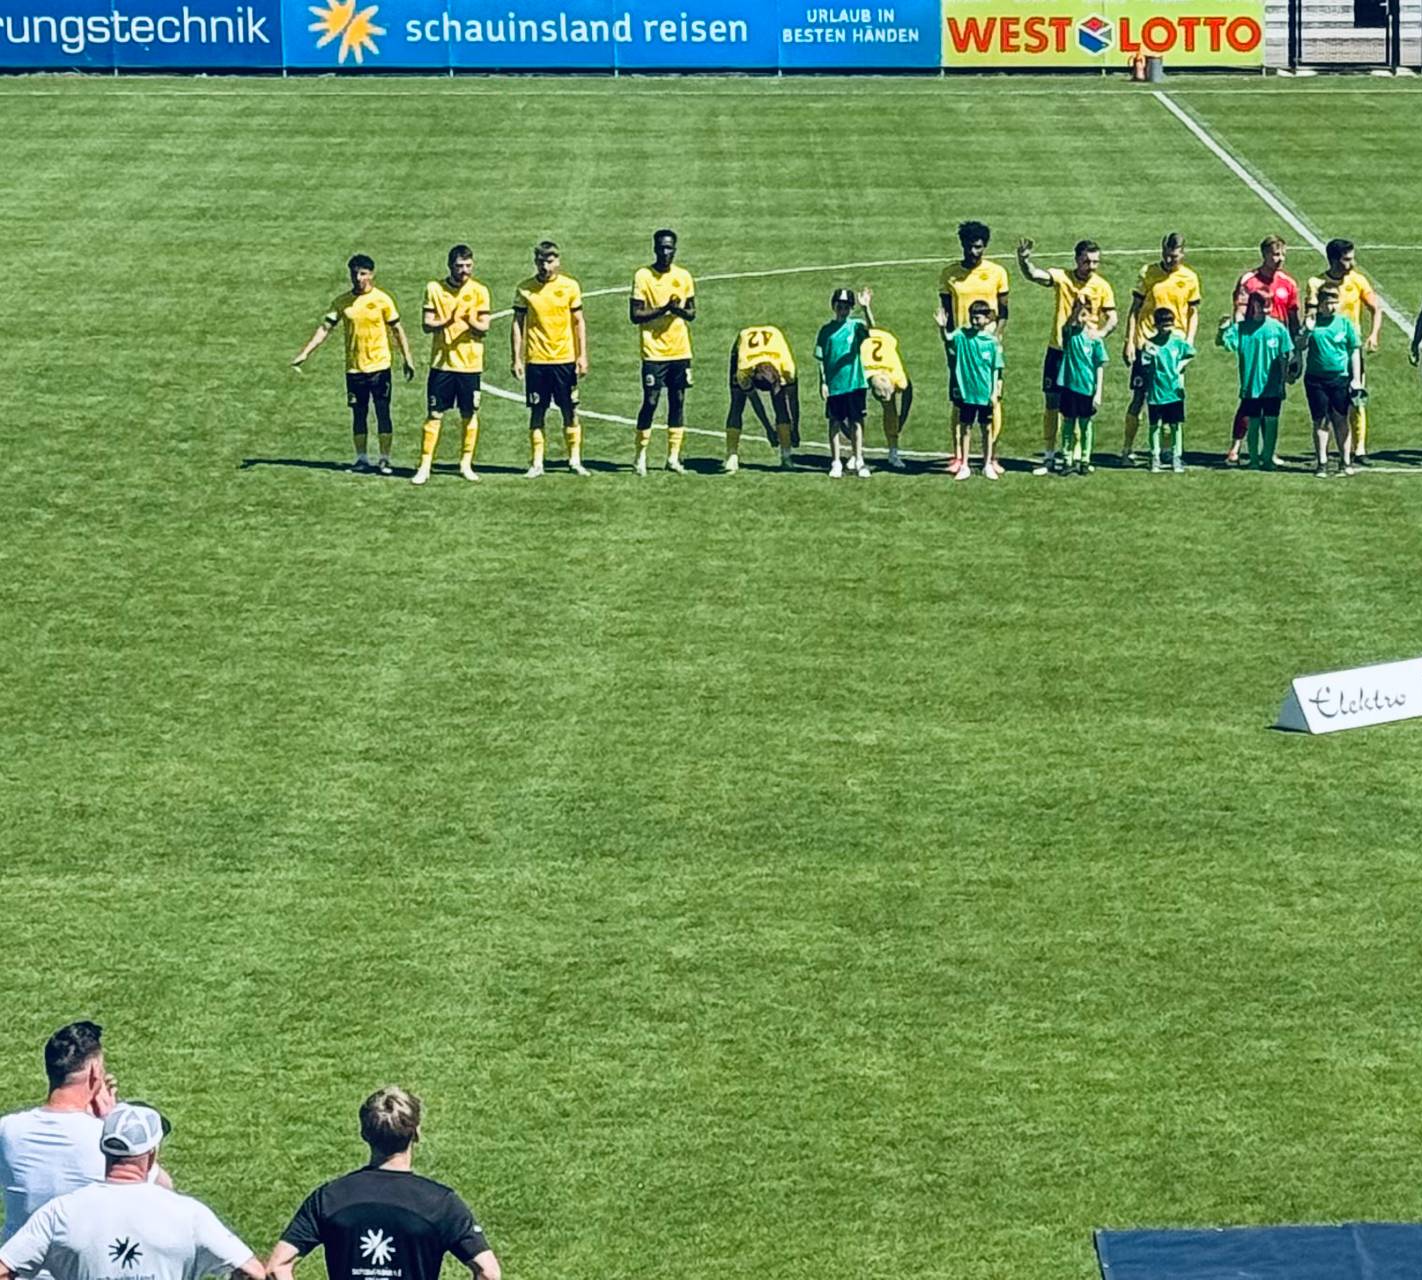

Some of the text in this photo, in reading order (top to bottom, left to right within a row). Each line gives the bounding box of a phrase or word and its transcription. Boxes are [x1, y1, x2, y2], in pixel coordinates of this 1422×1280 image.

[0, 6, 270, 54] ungstechnik
[405, 11, 748, 42] schauinsland reisen
[807, 8, 894, 23] URLAUB IN
[782, 25, 920, 43] BESTEN HÄNDEN
[946, 16, 1262, 53] WEST LOTTO
[1308, 686, 1407, 719] Elektro
